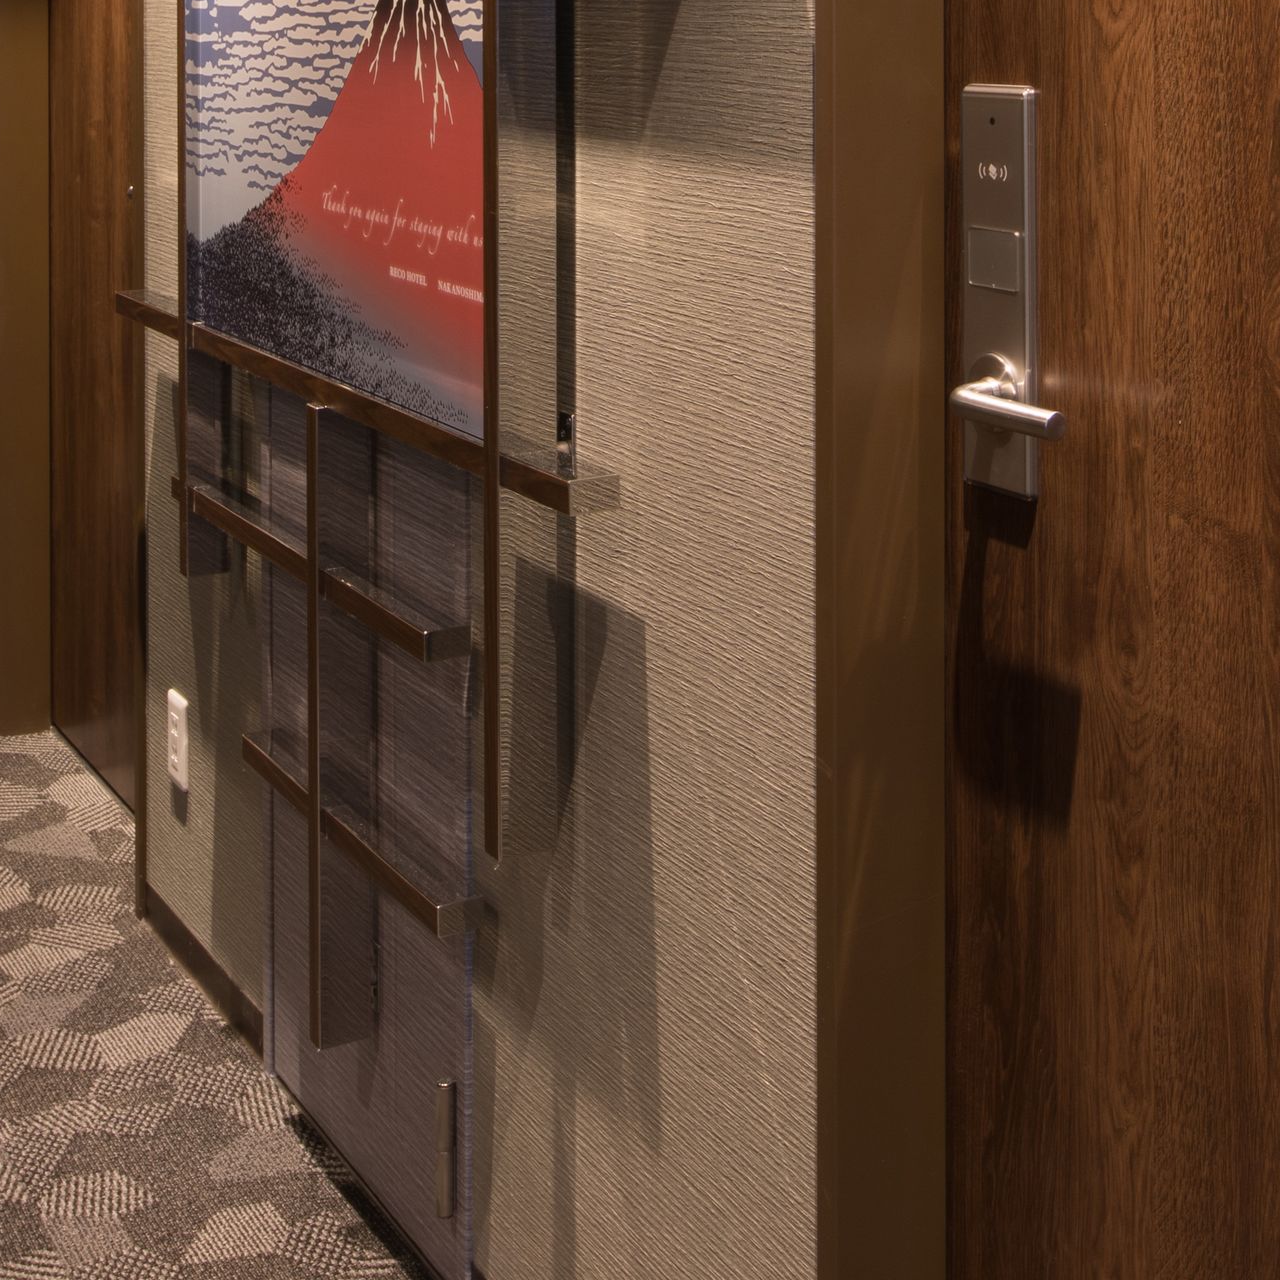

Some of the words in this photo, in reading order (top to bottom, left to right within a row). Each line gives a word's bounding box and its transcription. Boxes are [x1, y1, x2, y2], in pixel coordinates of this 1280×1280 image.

[322, 184, 350, 214] Thank
[344, 206, 362, 229] you
[363, 209, 389, 238] again
[383, 198, 407, 246] for
[409, 216, 443, 255] staying
[447, 214, 476, 245] with
[406, 270, 428, 287] HOTEL
